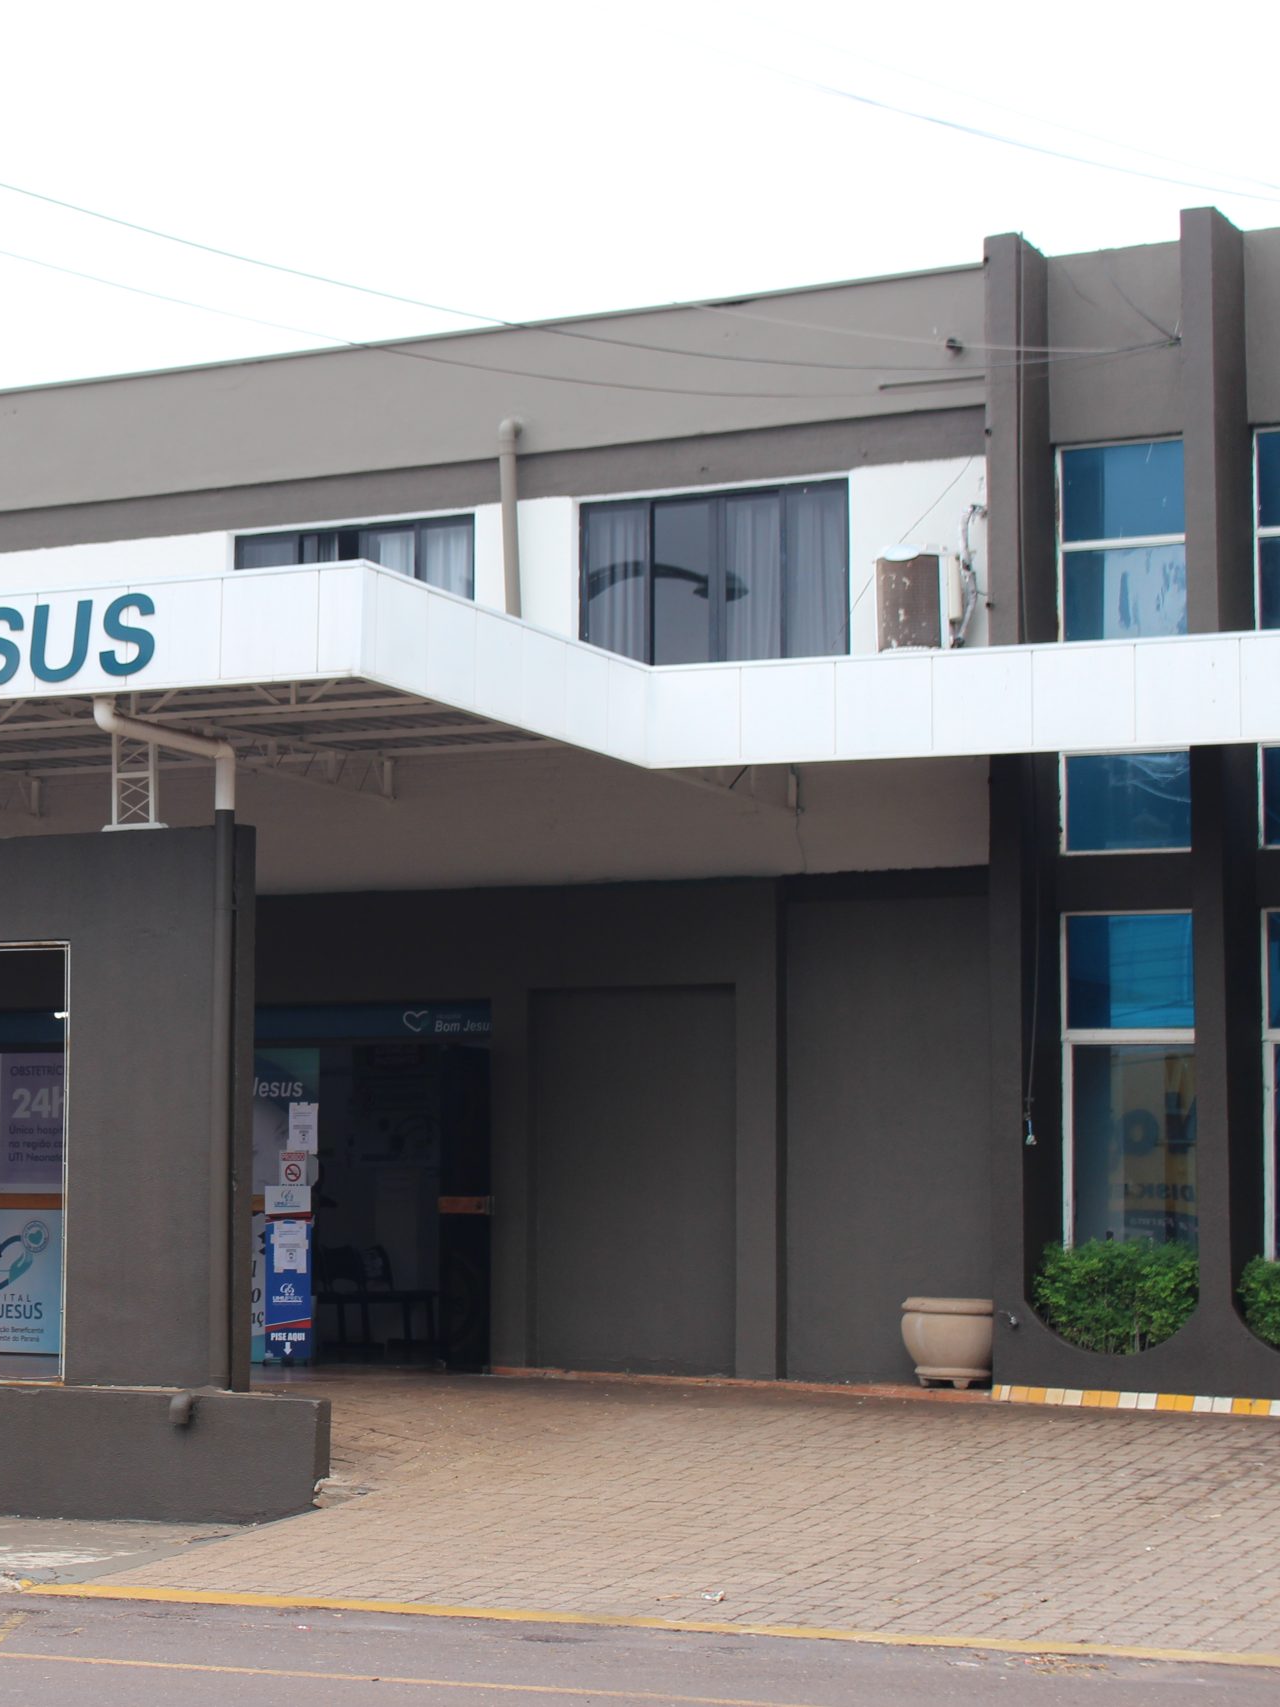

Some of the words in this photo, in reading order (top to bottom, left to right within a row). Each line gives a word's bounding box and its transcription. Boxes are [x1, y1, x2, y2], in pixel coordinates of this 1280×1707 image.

[434, 1019, 460, 1032] Bom
[463, 1019, 492, 1032] Jesu
[9, 1064, 64, 1077] OBSTETRÍC
[36, 1124, 64, 1138] hospit
[270, 1332, 287, 1341] PISE
[287, 1332, 306, 1342] AQUI
